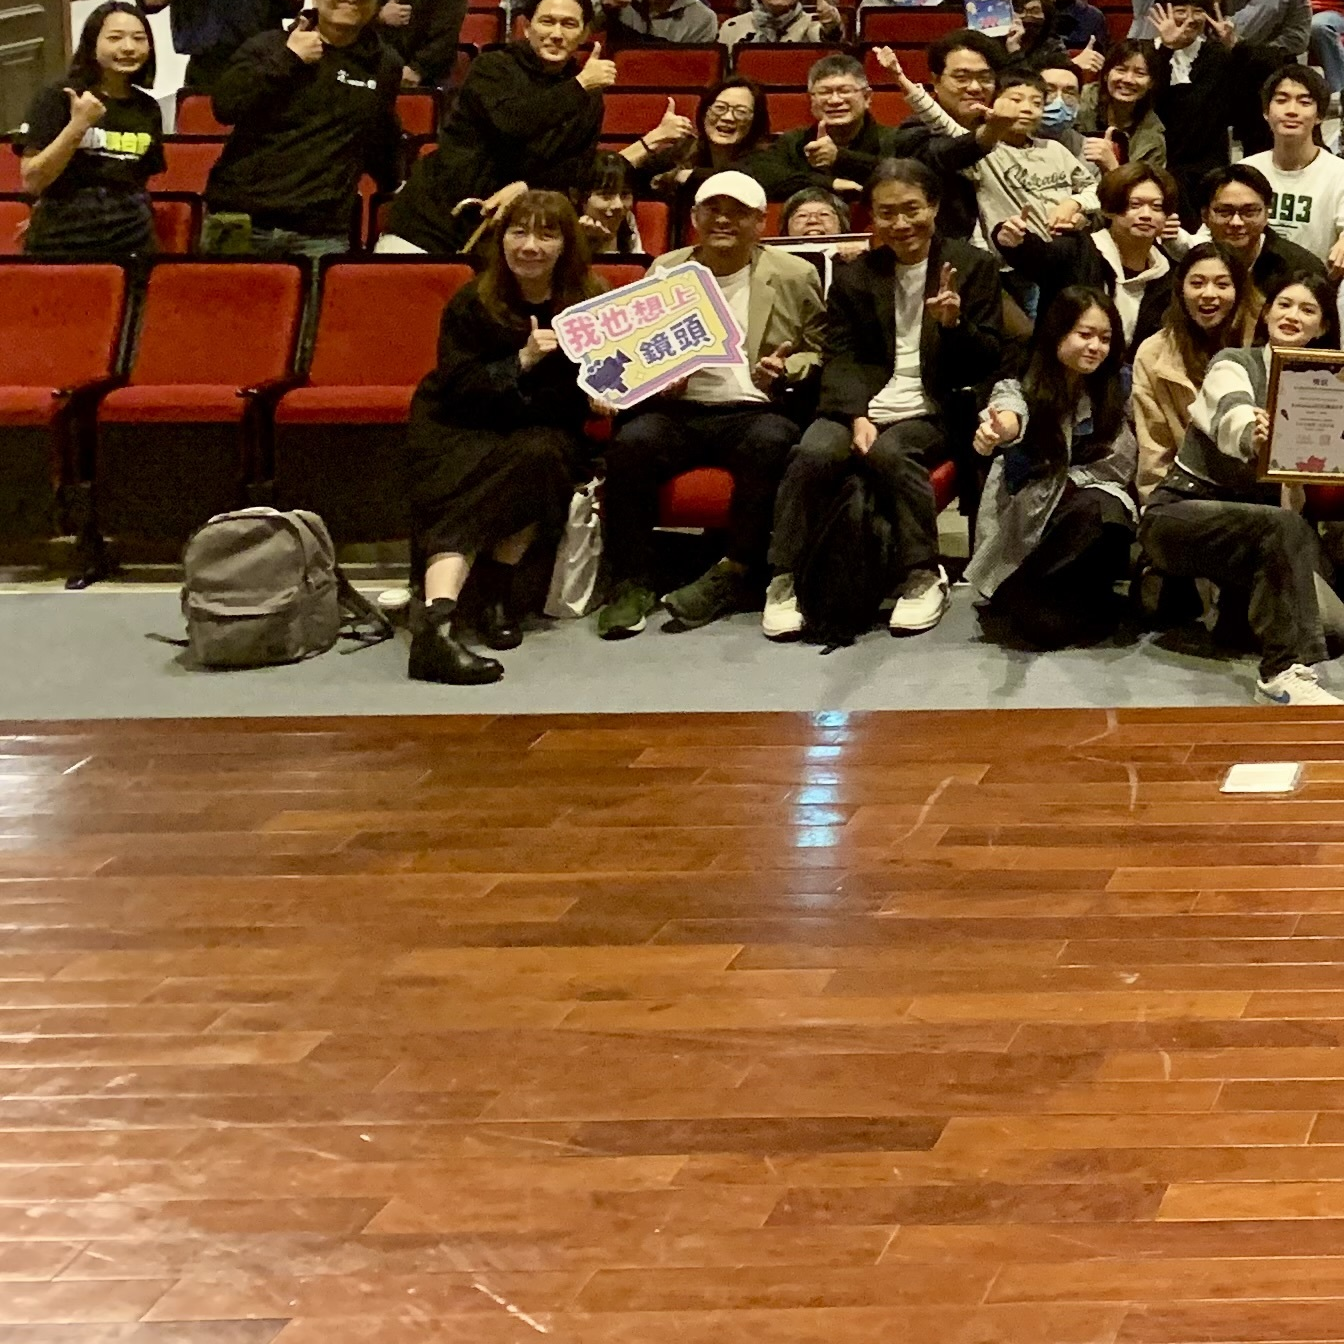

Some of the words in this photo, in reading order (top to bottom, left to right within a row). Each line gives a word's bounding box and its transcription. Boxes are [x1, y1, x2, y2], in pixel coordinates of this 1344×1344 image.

[562, 285, 699, 353] 我也想上
[639, 313, 711, 365] 鏡頭
